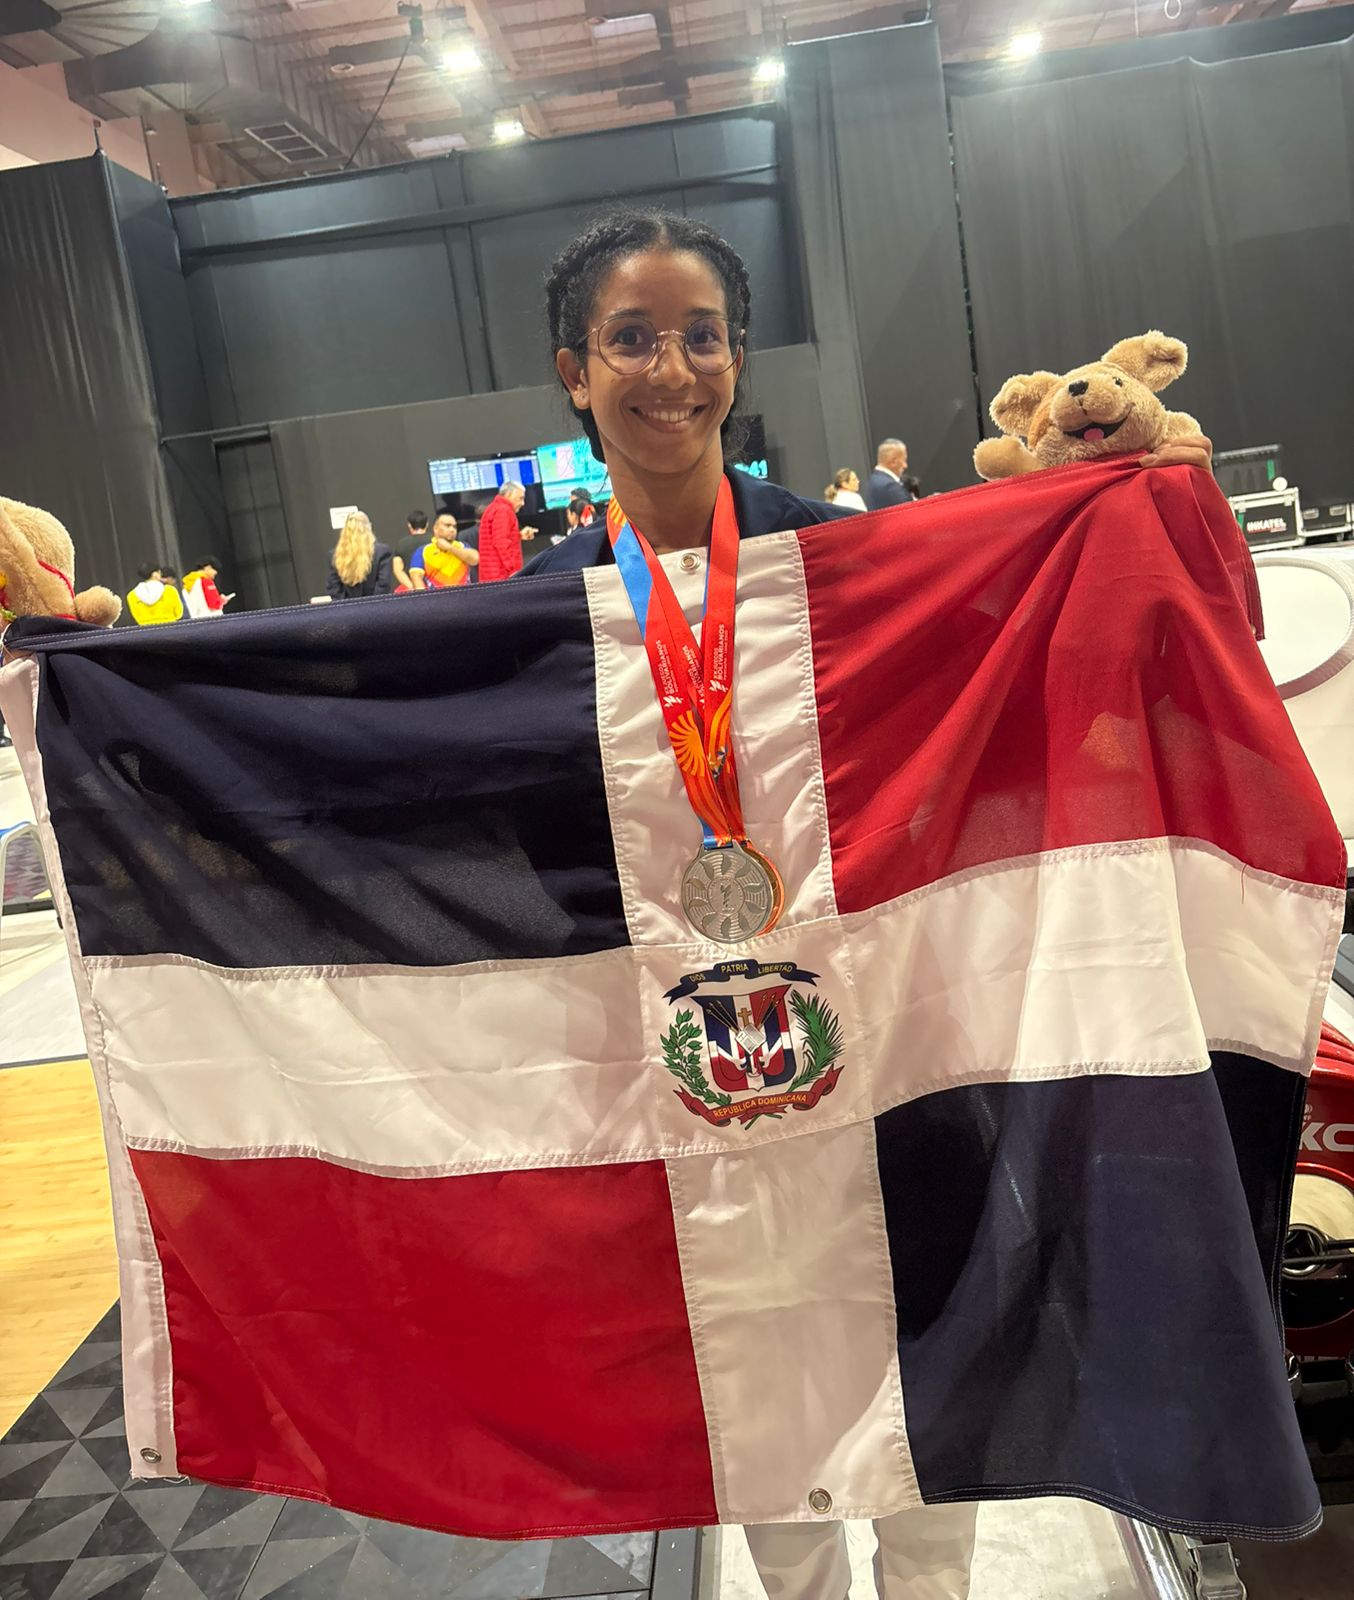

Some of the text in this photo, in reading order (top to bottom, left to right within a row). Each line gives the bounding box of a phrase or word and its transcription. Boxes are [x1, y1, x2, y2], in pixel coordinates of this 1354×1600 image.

[656, 640, 674, 694] BOLIVARIANOS
[717, 624, 725, 680] BOLIVARIANOS
[689, 963, 793, 983] DIOS PATRIA LIBERTAD
[713, 1094, 807, 1118] REPUBLICA DOMINICANA
